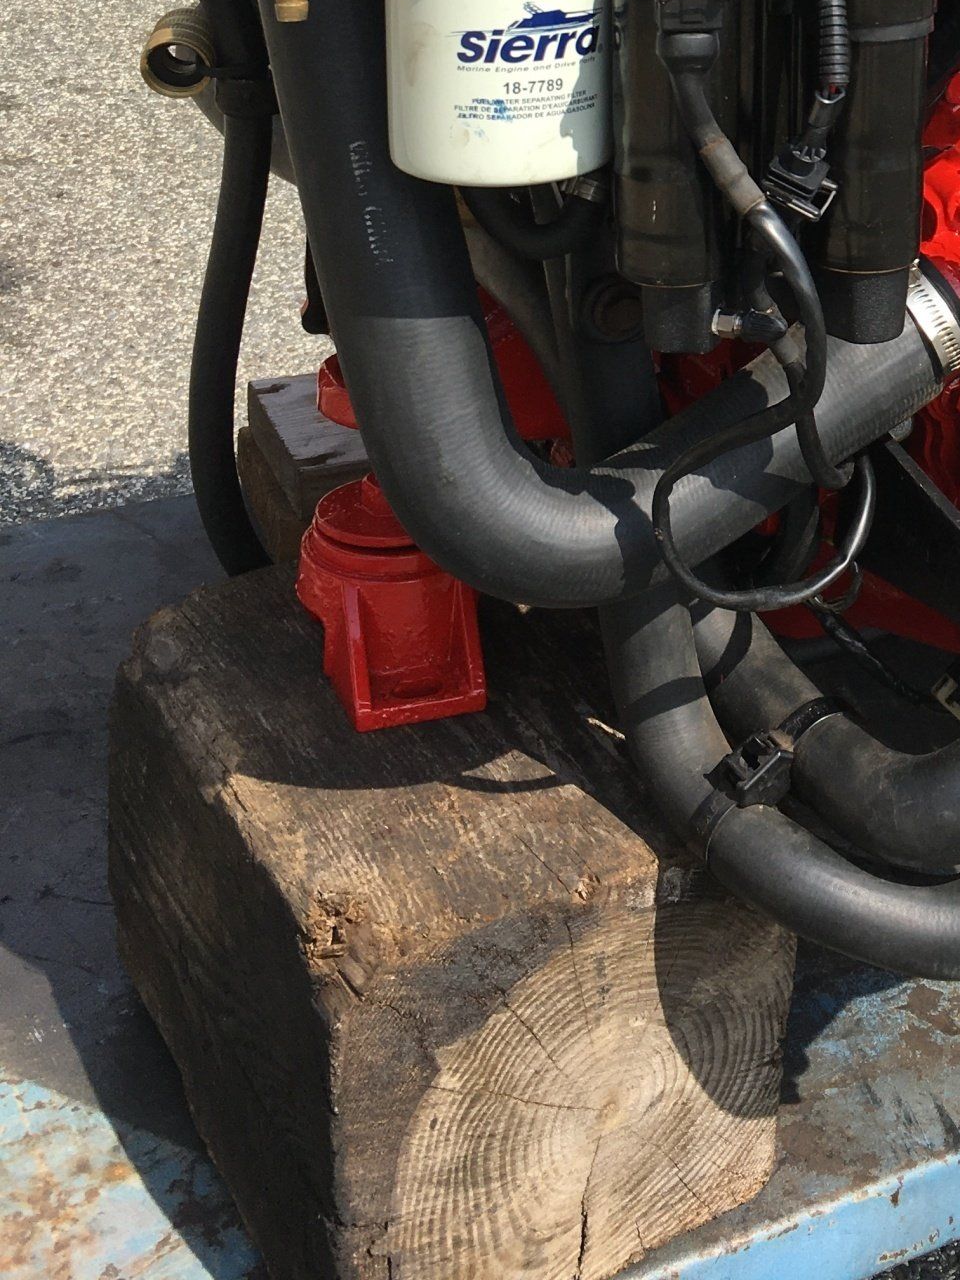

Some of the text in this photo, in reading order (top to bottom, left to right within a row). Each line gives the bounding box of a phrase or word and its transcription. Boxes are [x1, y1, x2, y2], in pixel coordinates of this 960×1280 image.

[457, 24, 600, 64] Sierra
[457, 65, 491, 73] Marine
[495, 65, 529, 74] Engine
[533, 63, 552, 71] and
[503, 77, 564, 95] 18-7789
